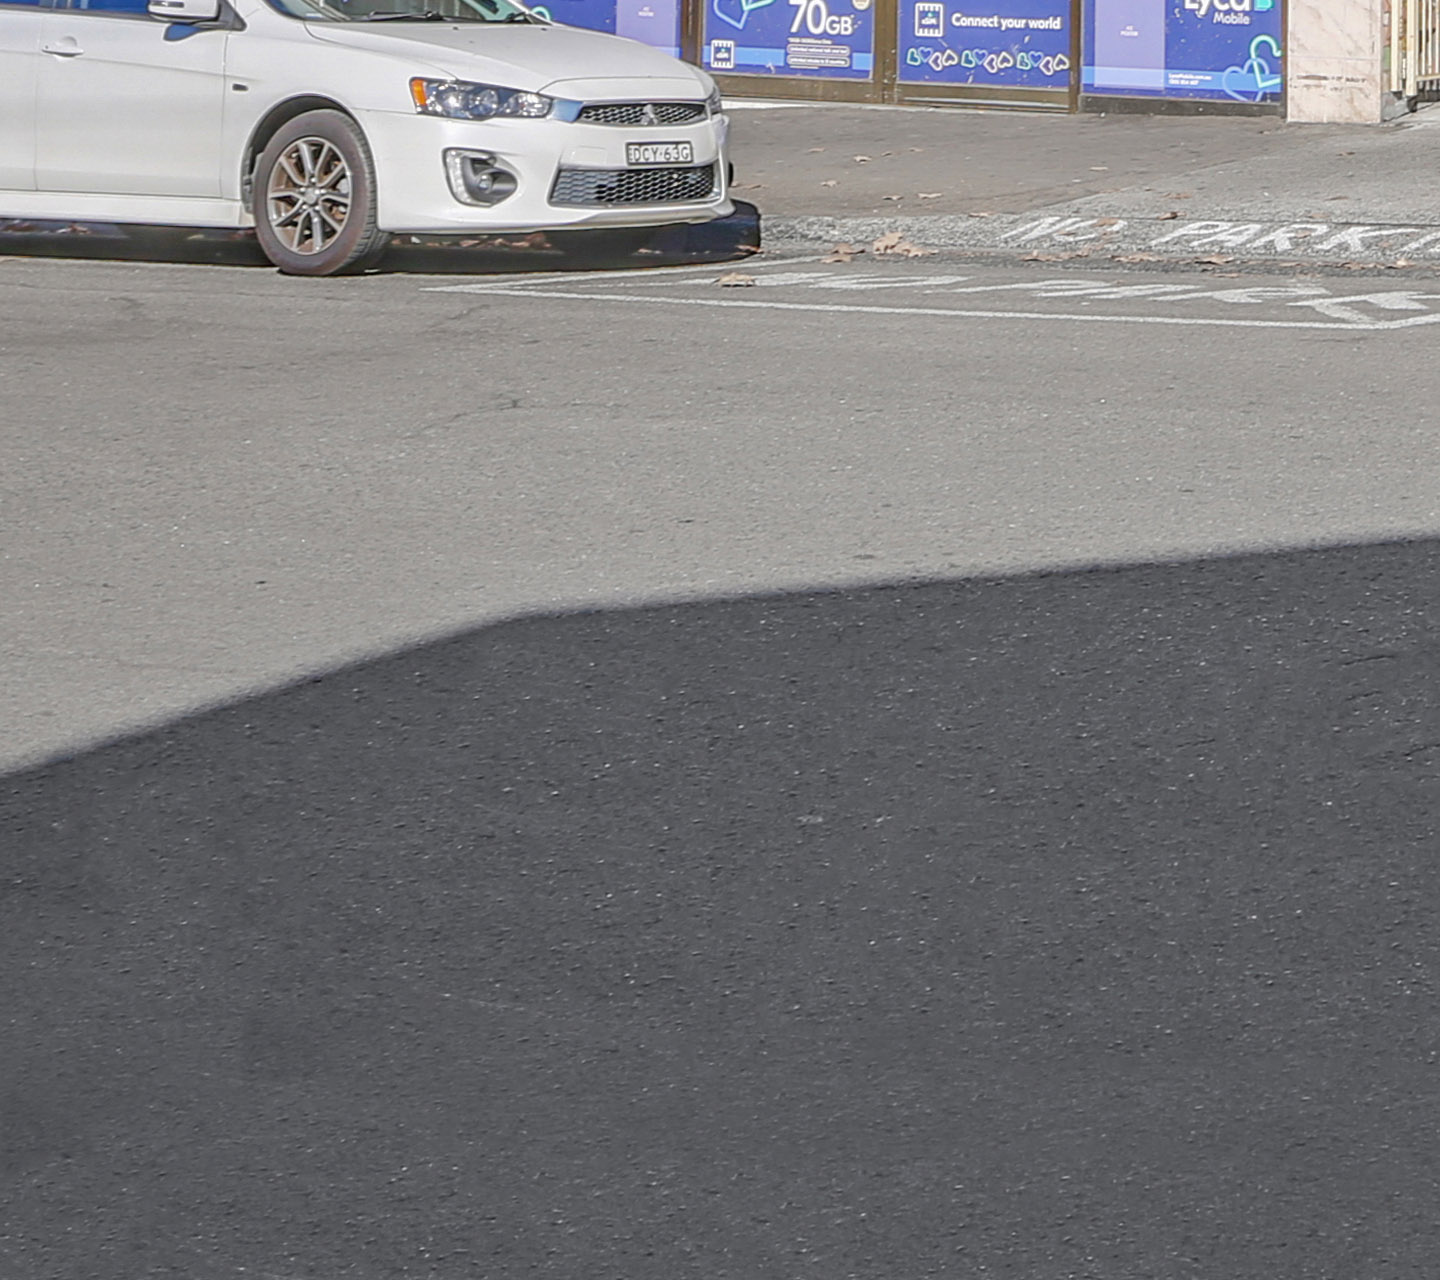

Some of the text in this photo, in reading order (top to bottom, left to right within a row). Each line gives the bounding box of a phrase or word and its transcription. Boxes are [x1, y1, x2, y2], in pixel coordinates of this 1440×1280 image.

[952, 13, 1061, 31] Connect your world
[1213, 12, 1250, 25] Mobile
